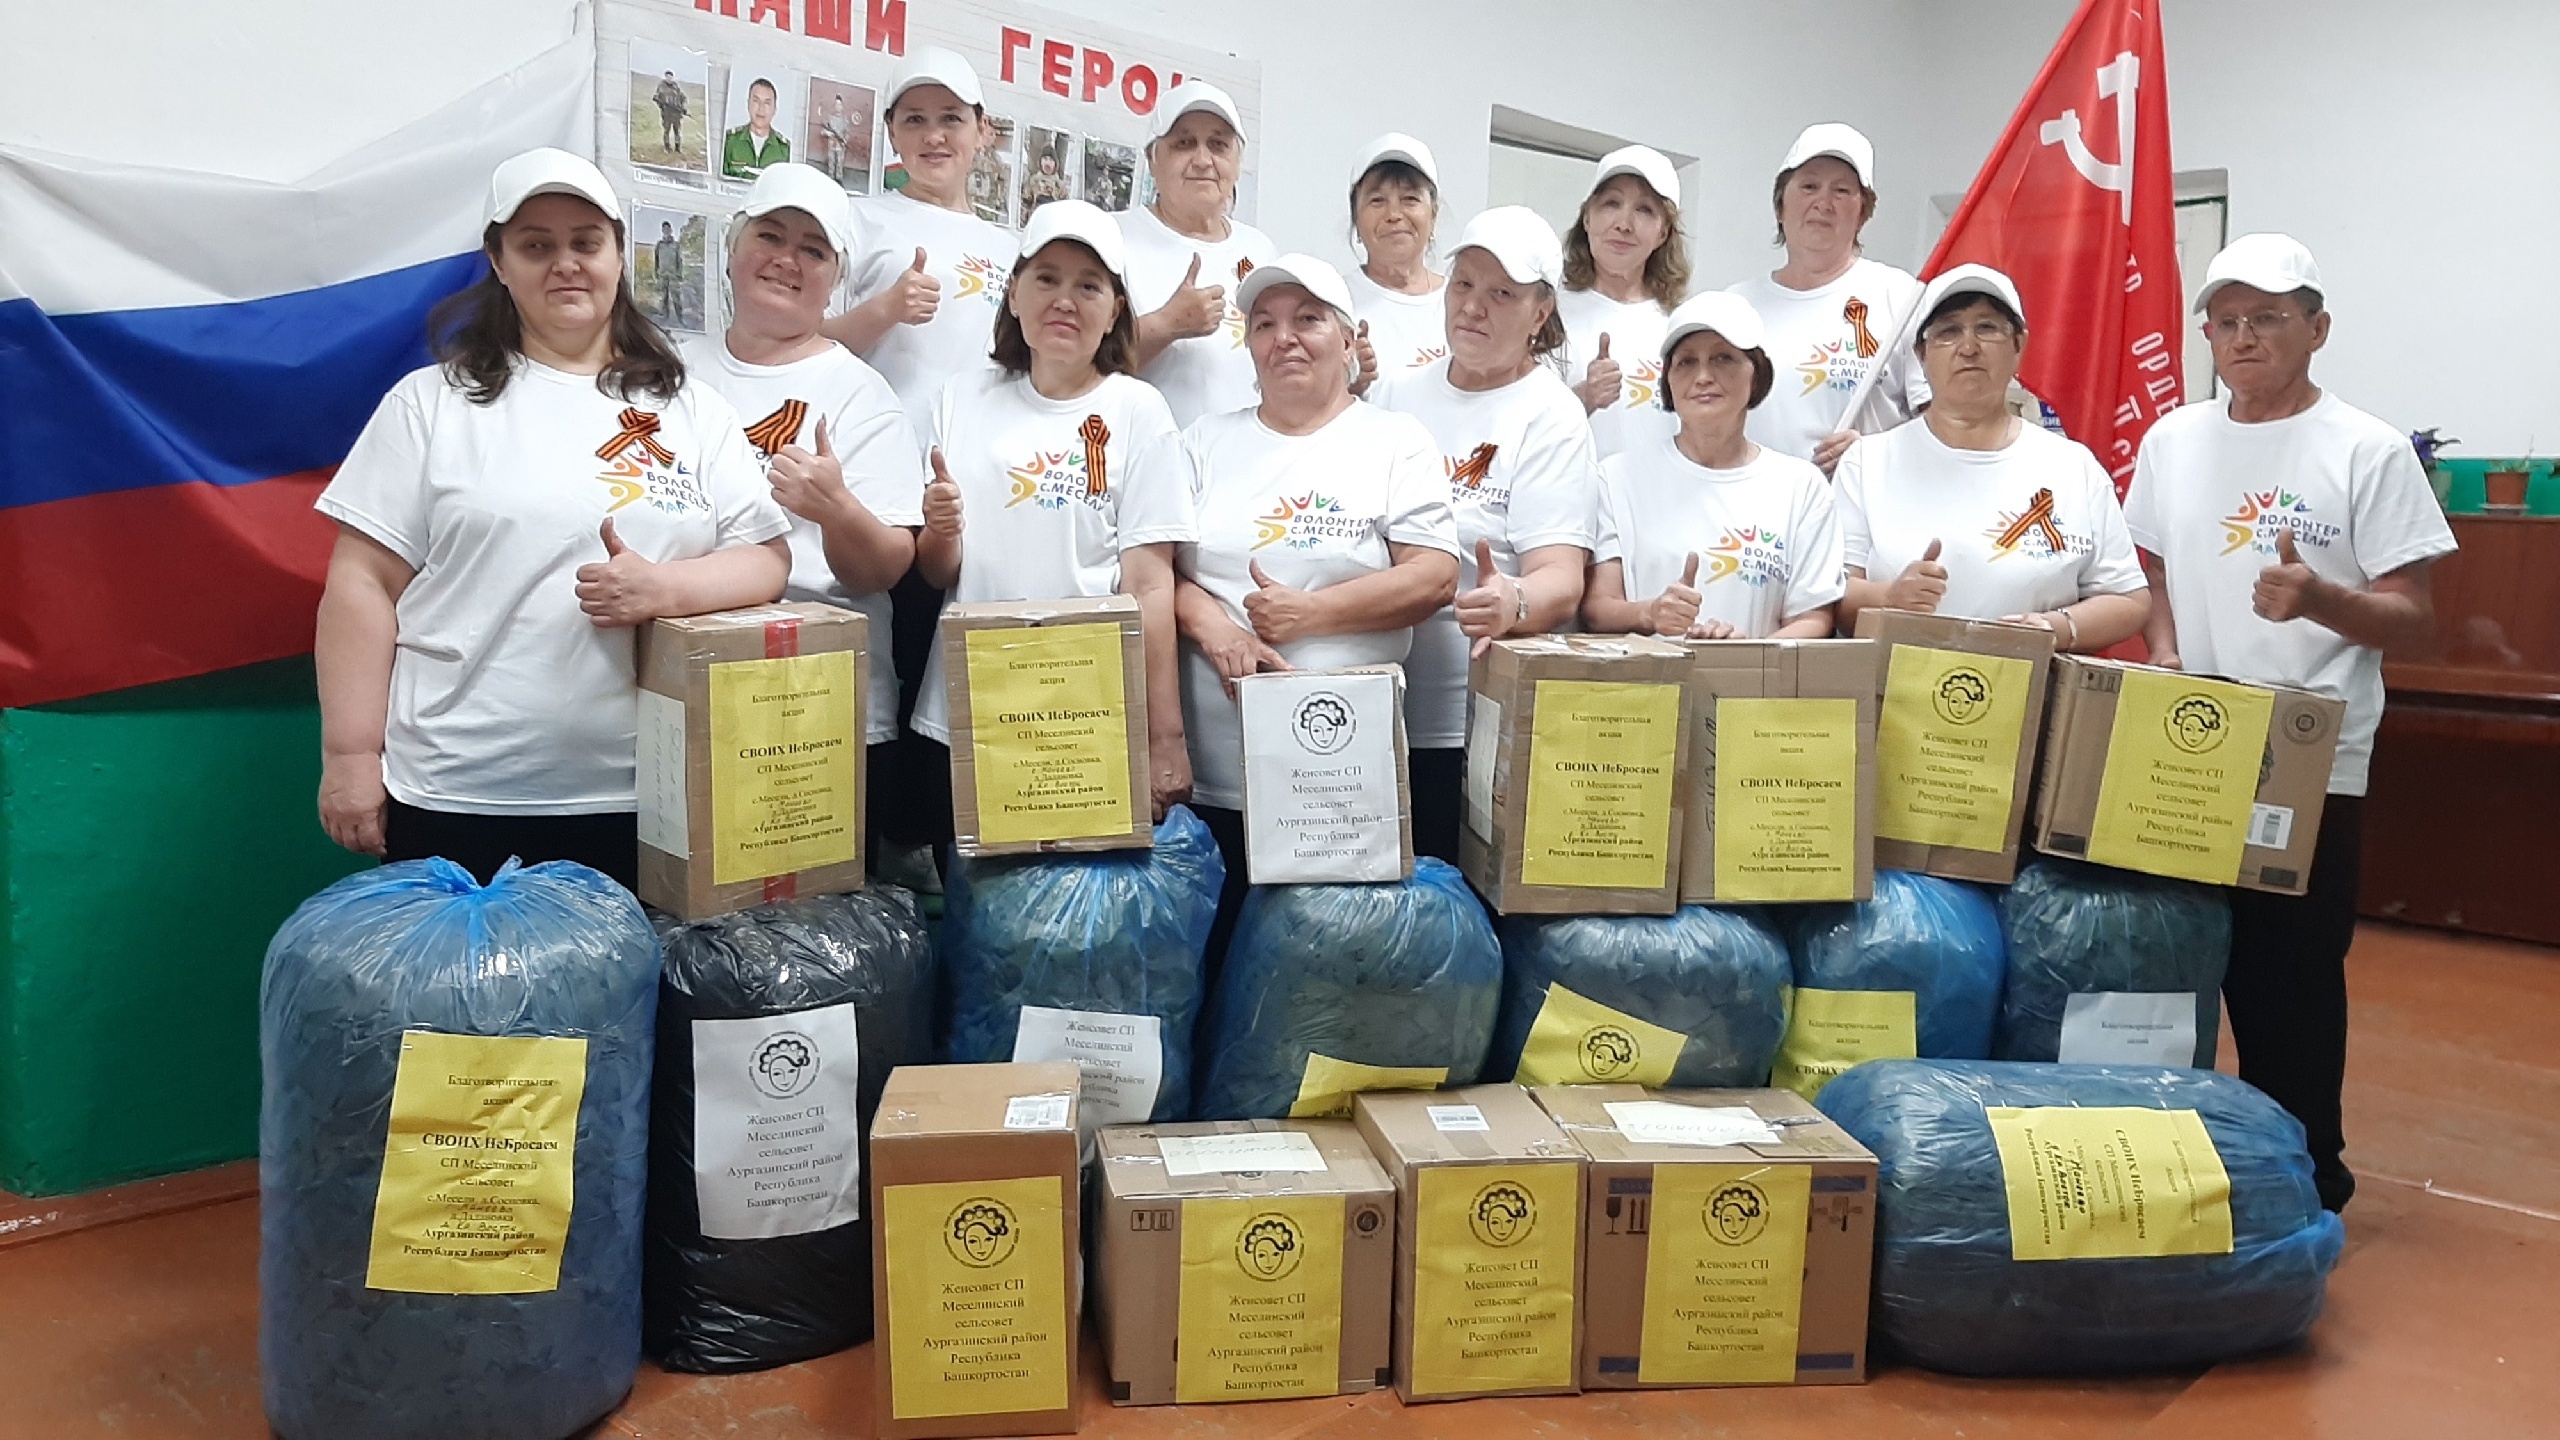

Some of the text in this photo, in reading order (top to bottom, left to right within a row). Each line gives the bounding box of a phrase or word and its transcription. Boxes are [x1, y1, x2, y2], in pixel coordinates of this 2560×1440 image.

[1001, 26, 1172, 115] ГЕРО
[2131, 332, 2180, 418] ОРДЕ
[1294, 515, 1373, 528] ВОЛОНТЕР
[2259, 514, 2341, 537] ВОЛОНТЕР
[1291, 526, 1365, 538] С.МЕСЕЛИ
[2256, 527, 2331, 548] С.МСЕЛИ
[999, 709, 1110, 724] СВОИХ НеБросаем
[1017, 731, 1032, 740] СП
[740, 737, 843, 759] СВОИХ НеБросаем
[757, 763, 772, 774] СП
[1291, 766, 1361, 778] Женсовет СП
[1555, 761, 1599, 773] СВОИХ
[2153, 759, 2223, 779] Женсовет СП
[1292, 783, 1362, 794] Меселинский
[2150, 774, 2221, 794] Меселинский
[1303, 800, 1353, 809] сельсовет
[2156, 793, 2207, 808] сельсовет
[1276, 815, 1383, 828] Аургазинский район
[2146, 819, 2206, 837] Республика
[1300, 831, 1359, 843] Республика
[2136, 834, 2210, 853] Башкортостан
[1294, 848, 1367, 859] Башкортостан
[1066, 1021, 1135, 1036] Женсовет СП
[1065, 1037, 1133, 1052] Меселинский
[1796, 1065, 1837, 1076] СВОИХ
[1081, 1084, 1118, 1095] ублика
[747, 1105, 825, 1125] Женсовет СП
[747, 1123, 825, 1142] Меселинский
[423, 1133, 558, 1153] СВОИХ НеБросаем
[758, 1143, 813, 1158] сельсовет
[440, 1158, 459, 1168] СП
[728, 1152, 843, 1178] Аургазинский район
[754, 1175, 820, 1191] Республика
[747, 1190, 828, 1208] Башкортостан
[404, 1244, 467, 1257] Республика
[1464, 1260, 1538, 1274] Женсовет СП
[1696, 1259, 1769, 1269] Женсовет СП
[941, 1279, 1024, 1294] Женсовет СП
[1465, 1278, 1538, 1291] Меселинский
[1694, 1276, 1768, 1287] Меселинский
[942, 1297, 1025, 1312] Меселинский
[1229, 1293, 1306, 1306] Женсовет СП
[1474, 1298, 1527, 1307] сельсовет
[1703, 1294, 1756, 1303] сельсовет
[1228, 1312, 1305, 1323] Меселинский
[1445, 1312, 1556, 1329] Аургазинский район
[1672, 1308, 1783, 1320] Аургазинский район
[955, 1318, 1014, 1329] сельсовет
[1239, 1331, 1293, 1340] сельсовет
[1468, 1330, 1531, 1343] Республика
[1696, 1325, 1758, 1337] Республика
[923, 1333, 1047, 1350] Аургазинский район
[1687, 1341, 1764, 1352] Башкортостан
[1208, 1344, 1323, 1359] Аургазинский район
[1461, 1346, 1538, 1359] Башкортостан
[951, 1352, 1021, 1366] Республика
[1232, 1363, 1297, 1376] Республика
[943, 1370, 1029, 1383] Башкортостан
[1225, 1379, 1304, 1391] Башкортостан
